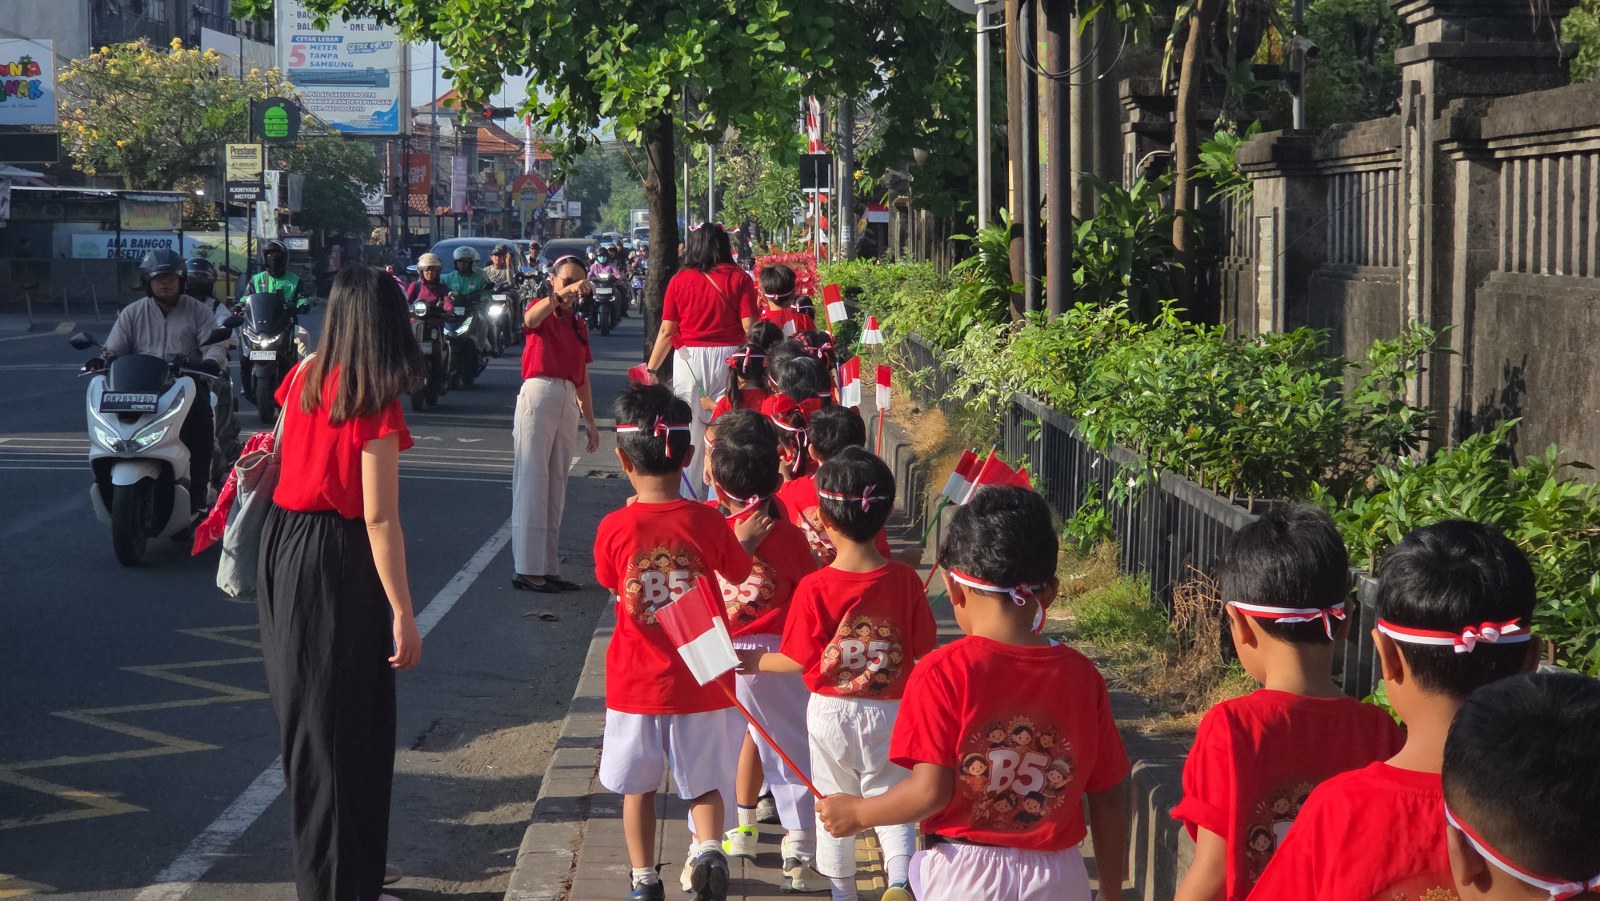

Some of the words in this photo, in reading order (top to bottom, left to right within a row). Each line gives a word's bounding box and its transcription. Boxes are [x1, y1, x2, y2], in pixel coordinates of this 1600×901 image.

[297, 23, 318, 31] BALI
[350, 23, 364, 31] ONE
[367, 23, 384, 31] WAY
[288, 44, 306, 68] 5
[230, 145, 258, 156] Prestone
[130, 238, 173, 249] BANGOR
[120, 249, 151, 260] SETIA
[640, 570, 690, 603] B5
[839, 639, 890, 672] B5
[986, 749, 1049, 796] B5
